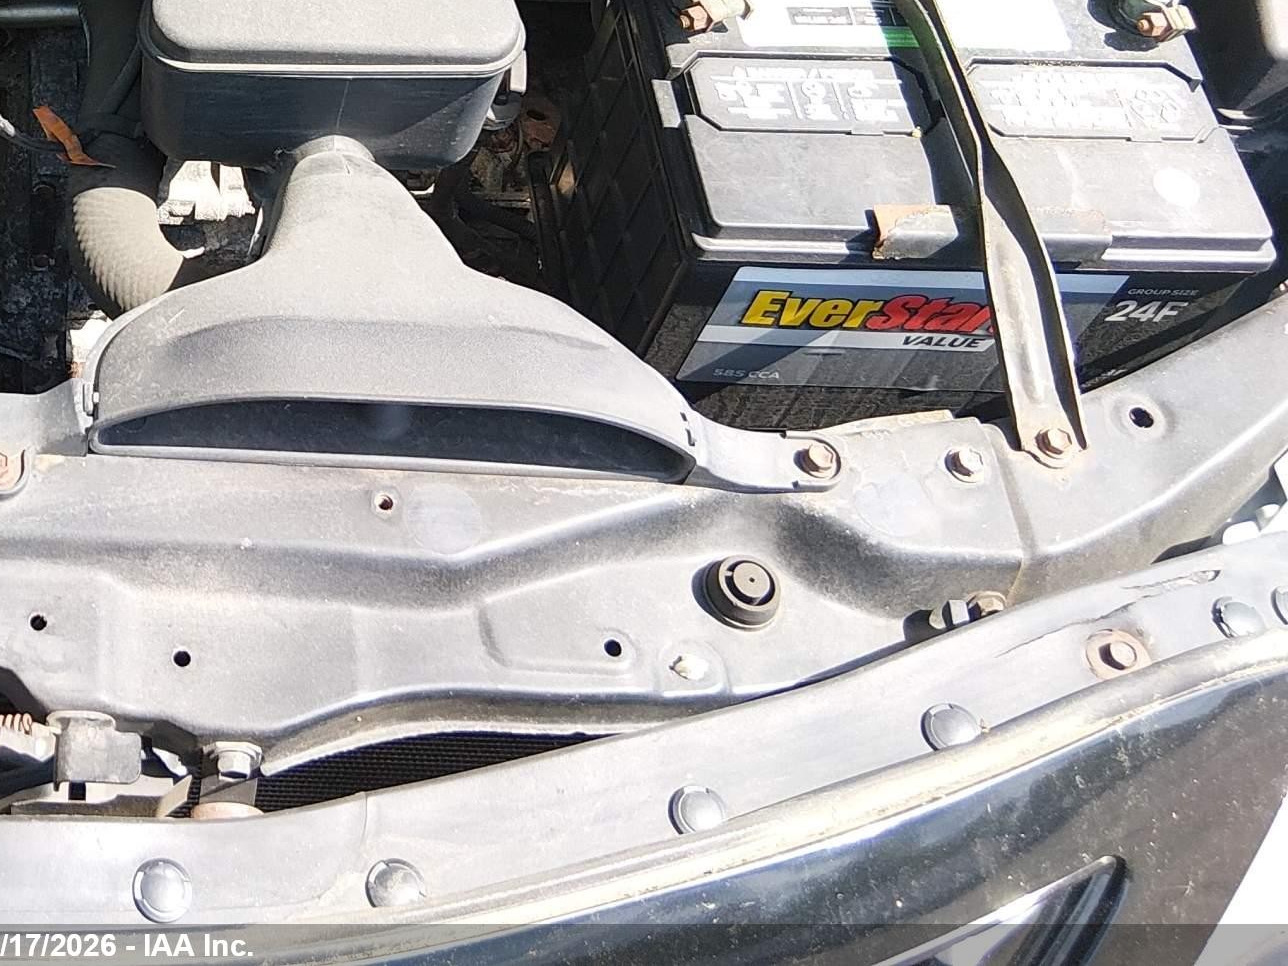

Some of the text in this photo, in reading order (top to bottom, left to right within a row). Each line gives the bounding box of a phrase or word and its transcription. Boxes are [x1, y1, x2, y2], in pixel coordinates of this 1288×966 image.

[1128, 288, 1171, 296] GROUP
[1103, 299, 1190, 323] 24F
[901, 335, 986, 350] VALUE
[748, 370, 781, 380] CCA
